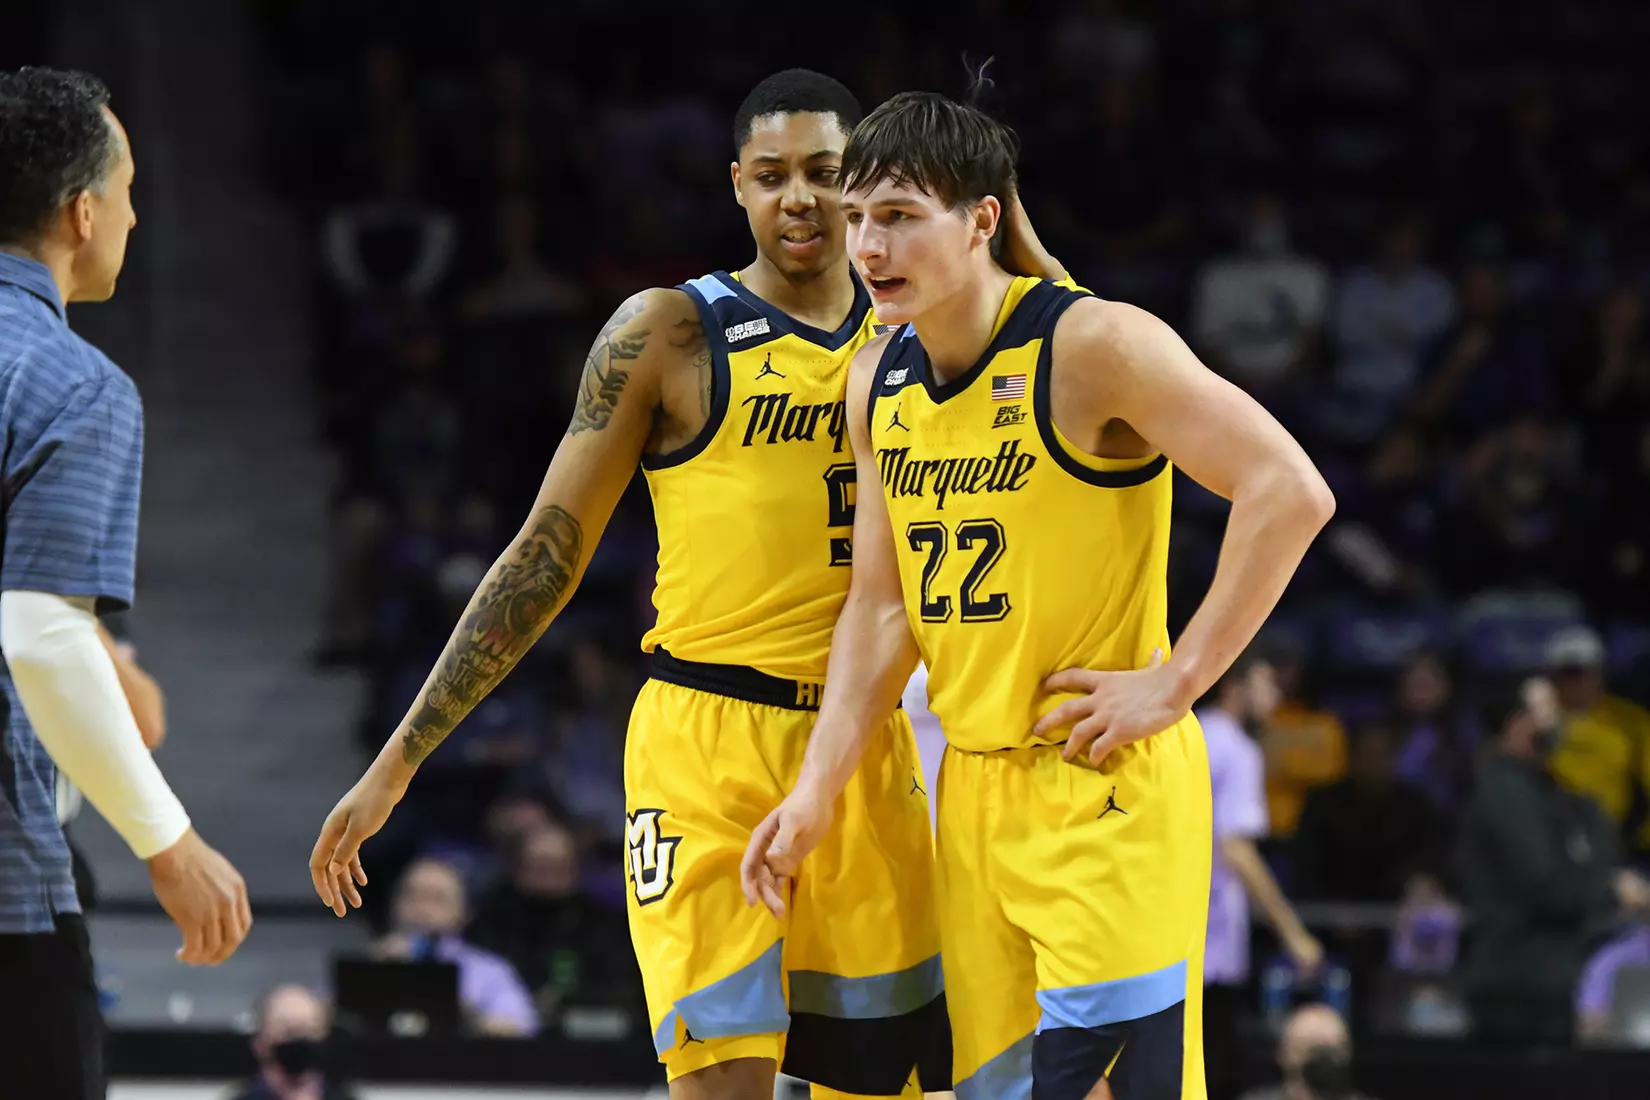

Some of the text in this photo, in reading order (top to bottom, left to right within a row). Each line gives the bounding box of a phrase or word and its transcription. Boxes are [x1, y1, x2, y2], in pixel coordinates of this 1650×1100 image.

[728, 325, 770, 343] CHANGE
[741, 392, 847, 453] Marq
[994, 412, 1027, 424] EAST
[997, 405, 1021, 415] BIG
[876, 438, 1037, 511] Marquette
[906, 517, 1012, 623] 22
[627, 808, 683, 907] MU
